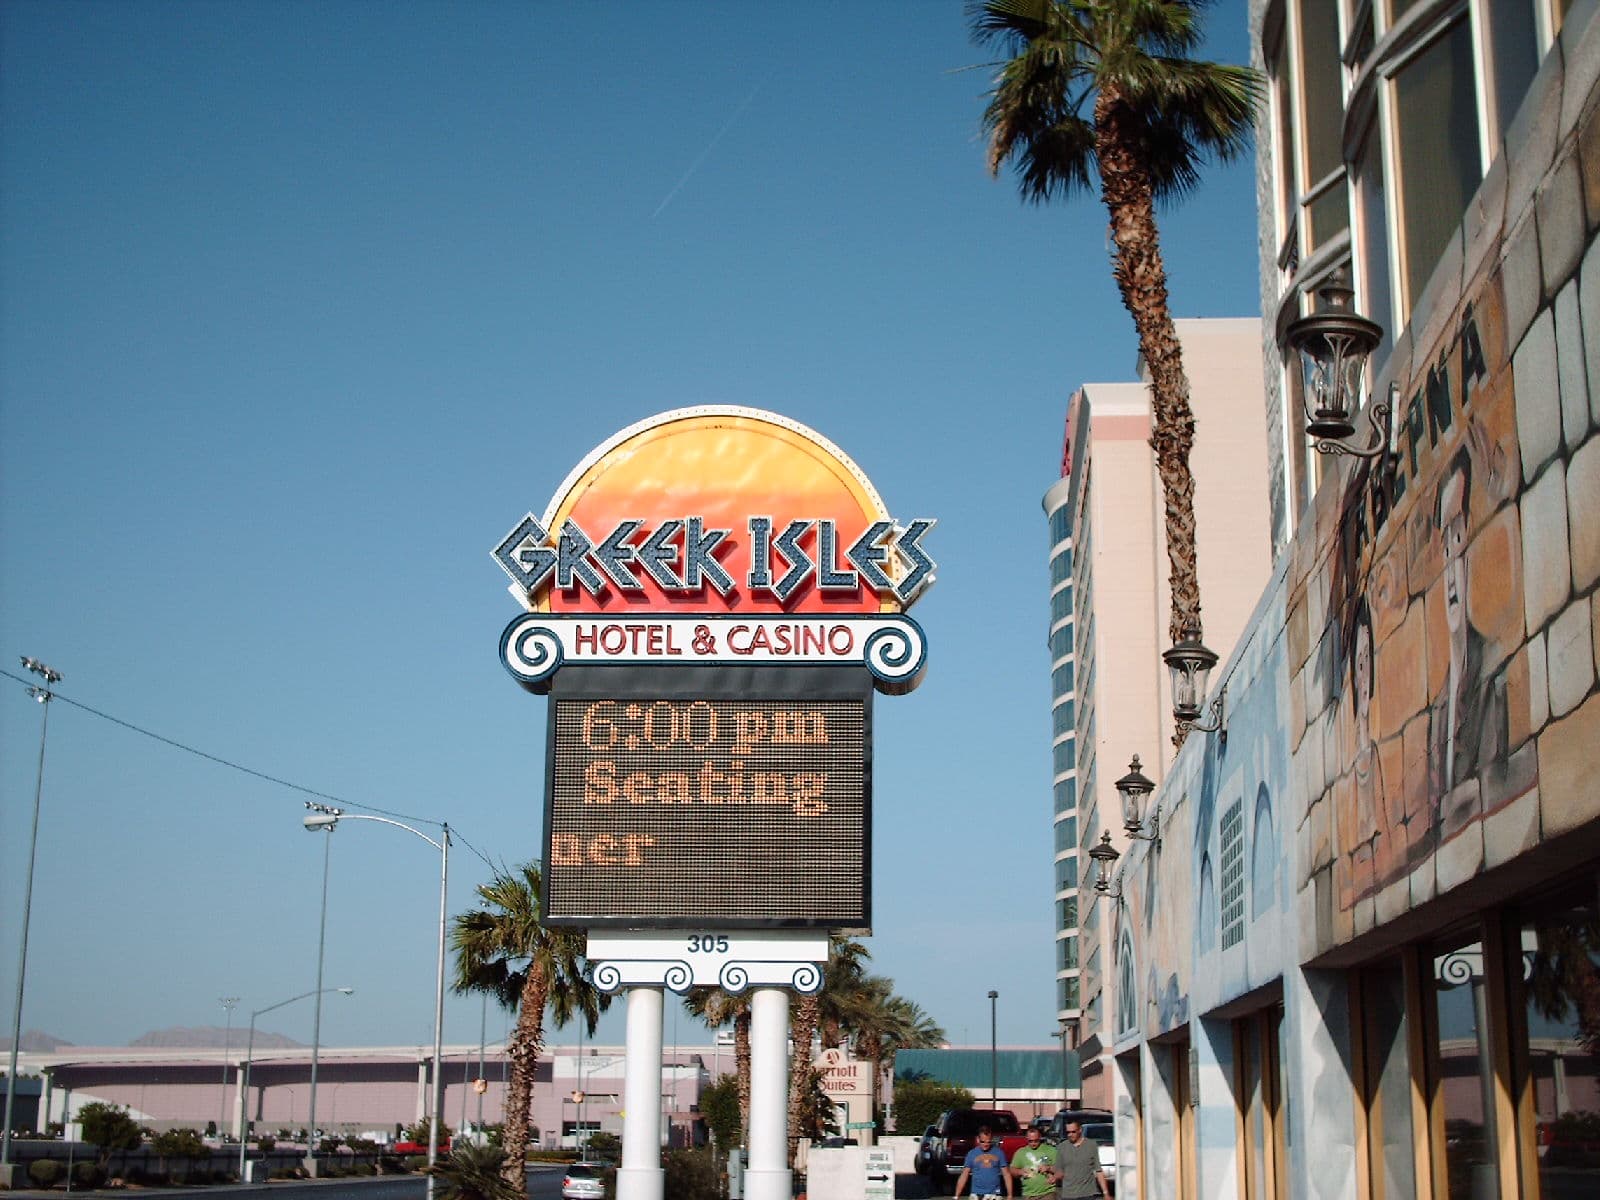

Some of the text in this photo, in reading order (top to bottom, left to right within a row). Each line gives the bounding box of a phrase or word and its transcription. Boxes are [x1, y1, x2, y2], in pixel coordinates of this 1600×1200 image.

[490, 512, 938, 601] GREEK ISLES
[574, 624, 854, 656] HOTEL & CASINO
[583, 700, 830, 754] 6:00 pm
[583, 760, 830, 816] Seating
[687, 934, 729, 953] 305
